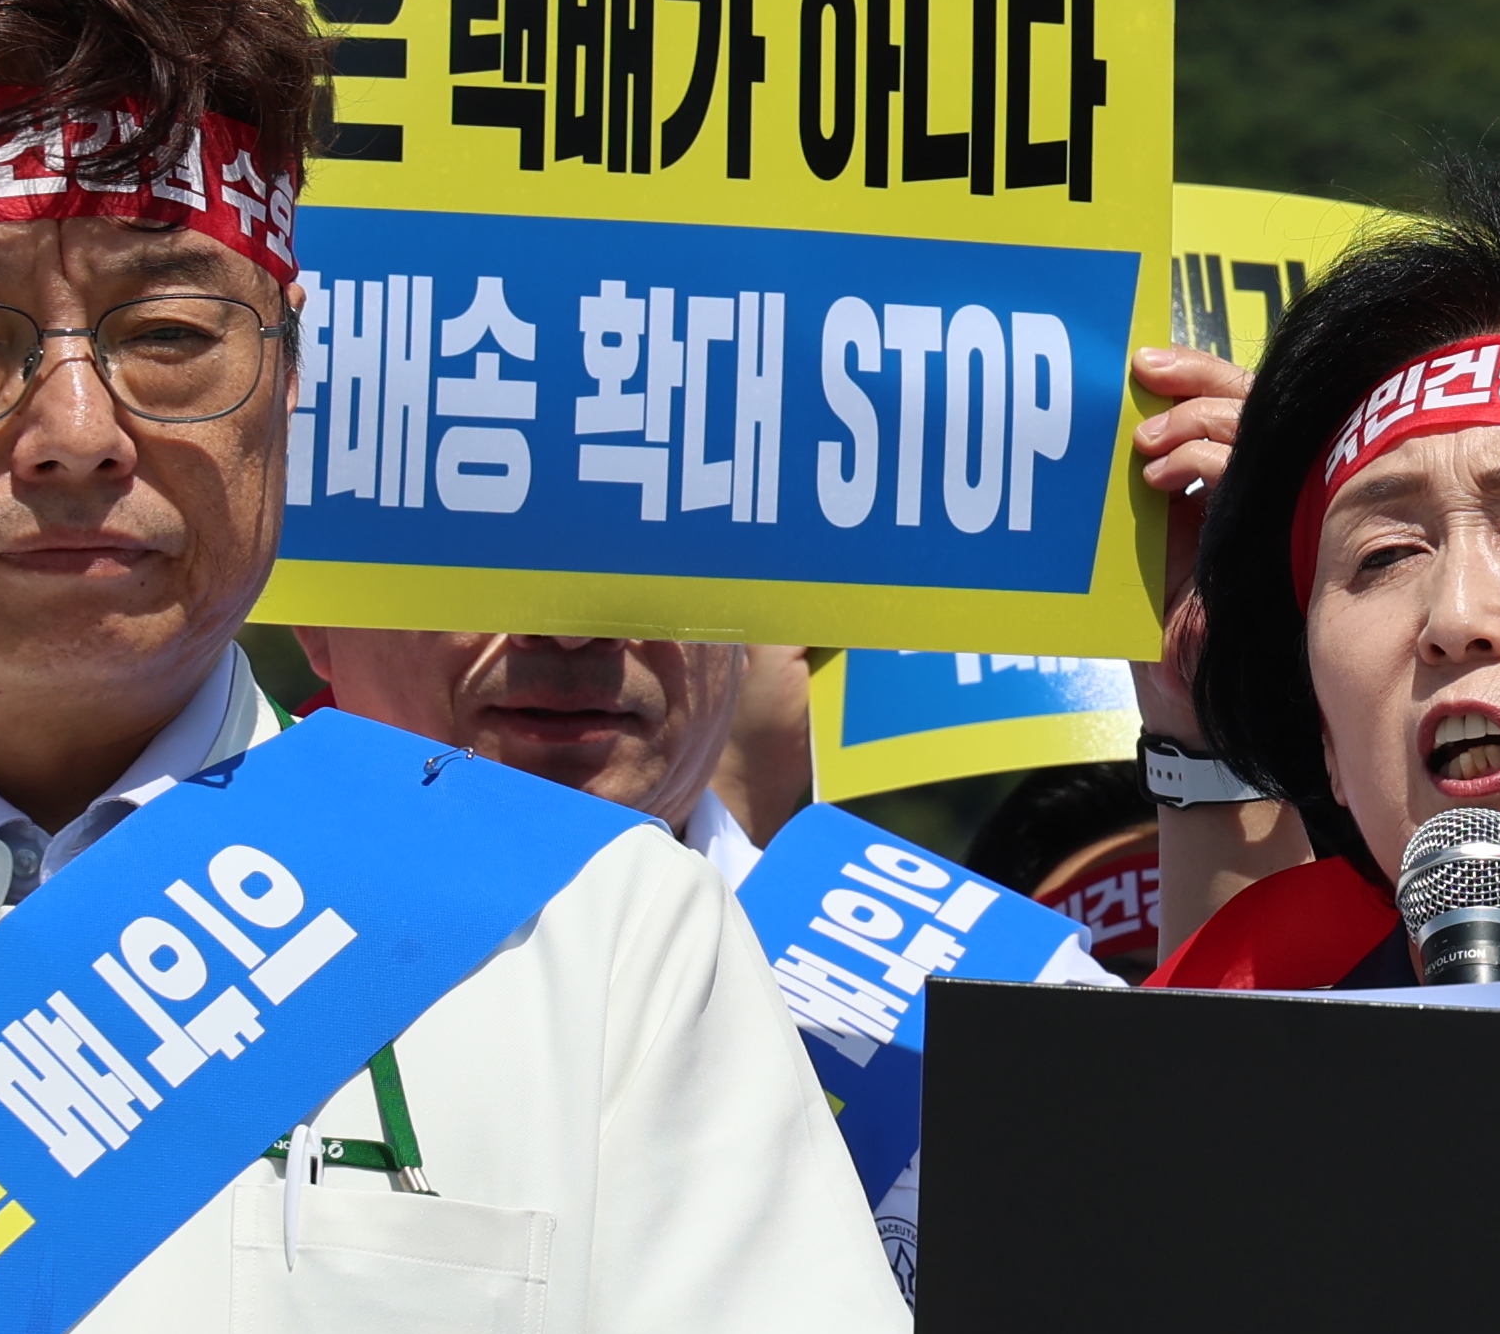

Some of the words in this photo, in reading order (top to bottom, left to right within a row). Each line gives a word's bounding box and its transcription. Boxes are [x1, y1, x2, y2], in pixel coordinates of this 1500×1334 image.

[575, 278, 785, 526] 확대
[815, 293, 1073, 535] STOP
[771, 843, 1001, 1069] 의약품
